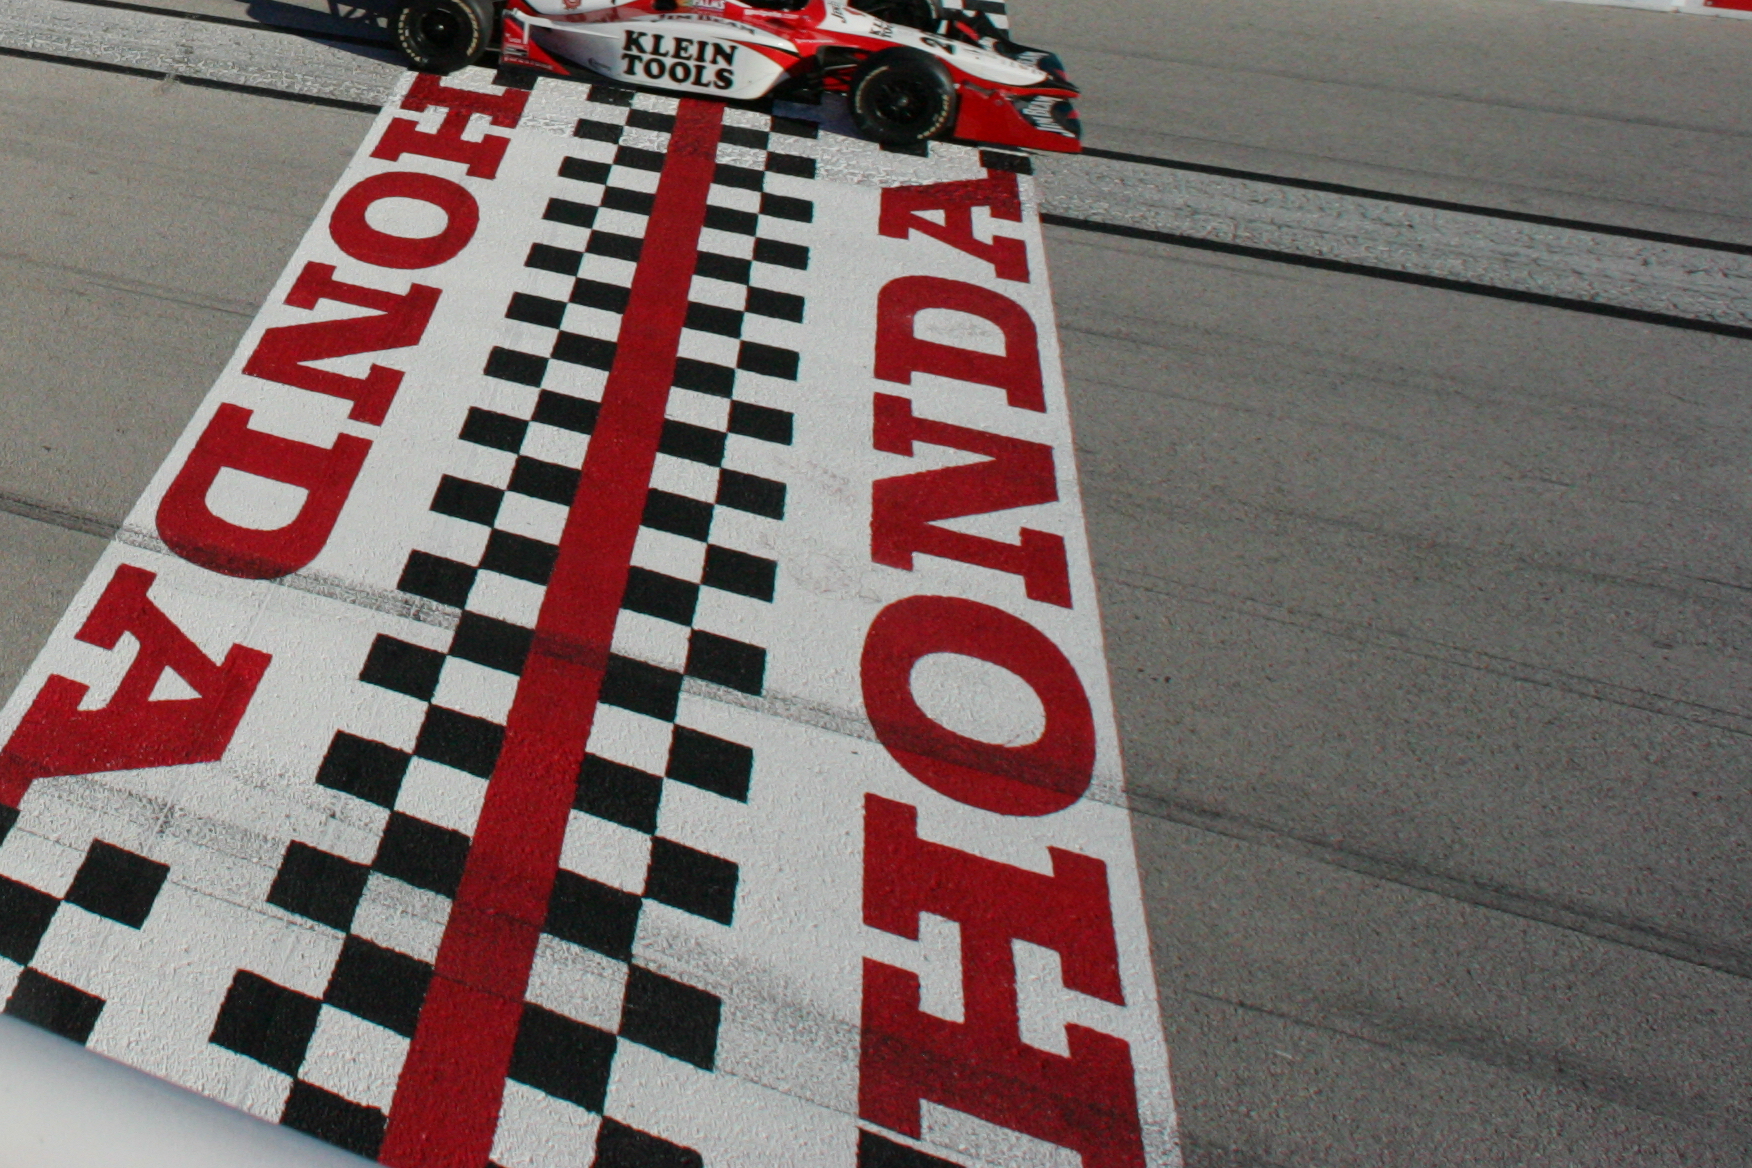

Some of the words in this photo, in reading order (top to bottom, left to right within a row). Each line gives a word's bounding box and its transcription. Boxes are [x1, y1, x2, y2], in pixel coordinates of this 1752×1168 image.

[622, 30, 740, 67] KLEIN
[621, 53, 735, 91] TOOLS
[857, 168, 1147, 1168] HONDA
